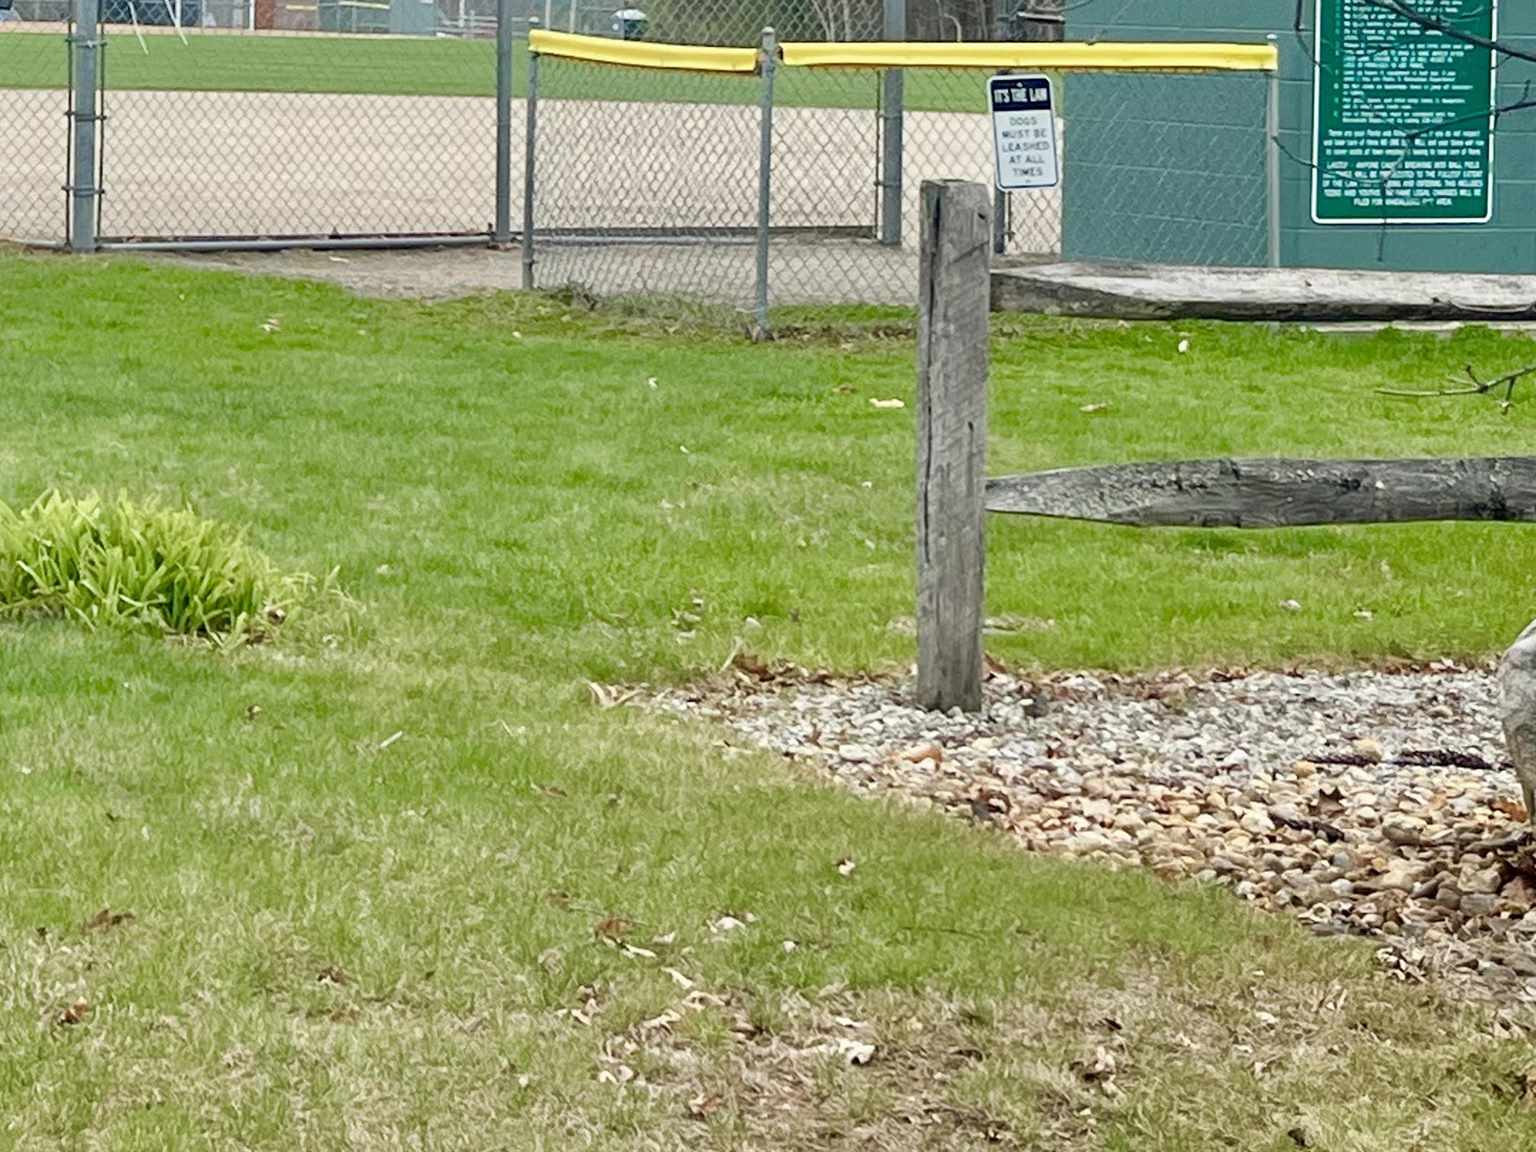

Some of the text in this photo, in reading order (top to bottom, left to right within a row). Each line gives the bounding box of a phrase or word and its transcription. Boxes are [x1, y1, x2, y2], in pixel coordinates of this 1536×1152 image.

[1008, 116, 1038, 126] DOGS
[1001, 129, 1029, 139] MUST
[1002, 141, 1049, 152] LEASHED
[1009, 155, 1044, 164] AT ALL
[1012, 168, 1043, 177] TIMES
